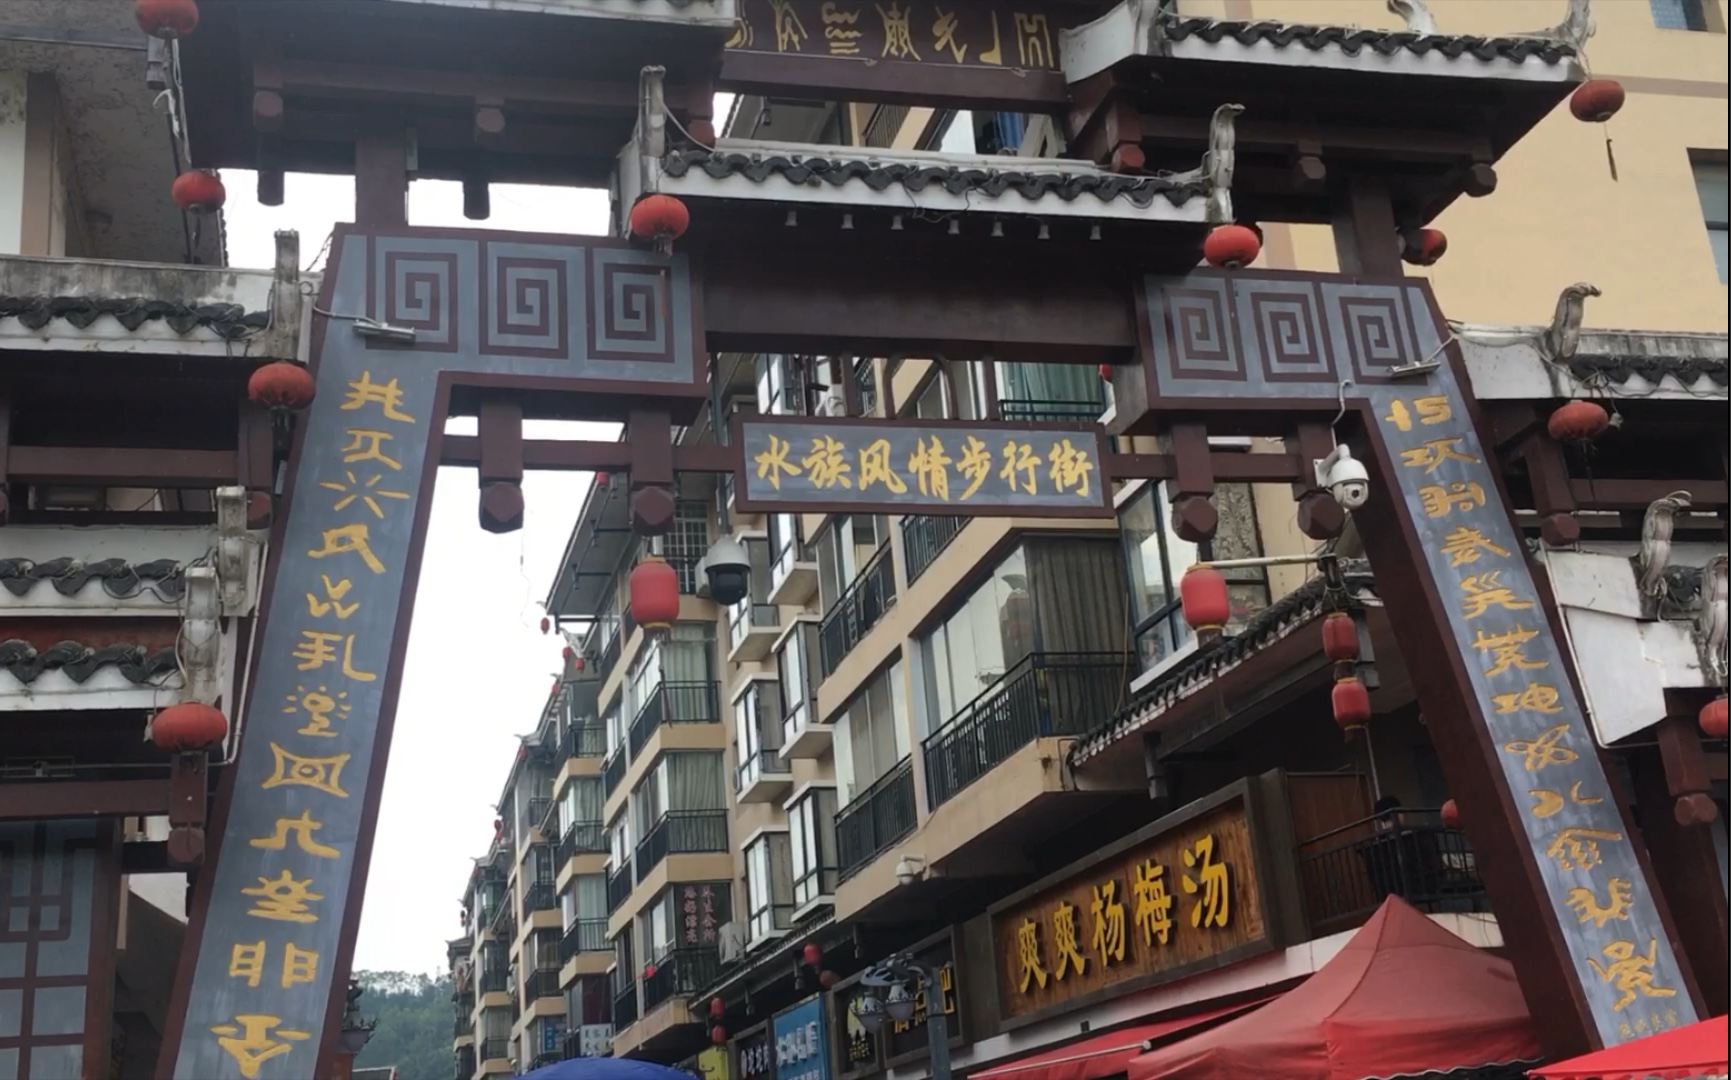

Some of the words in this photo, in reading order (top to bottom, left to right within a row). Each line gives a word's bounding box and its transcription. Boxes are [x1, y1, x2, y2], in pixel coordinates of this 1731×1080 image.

[754, 433, 1094, 501] 水族风情步行街
[1018, 833, 1230, 993] 爽爽杨梅汤
